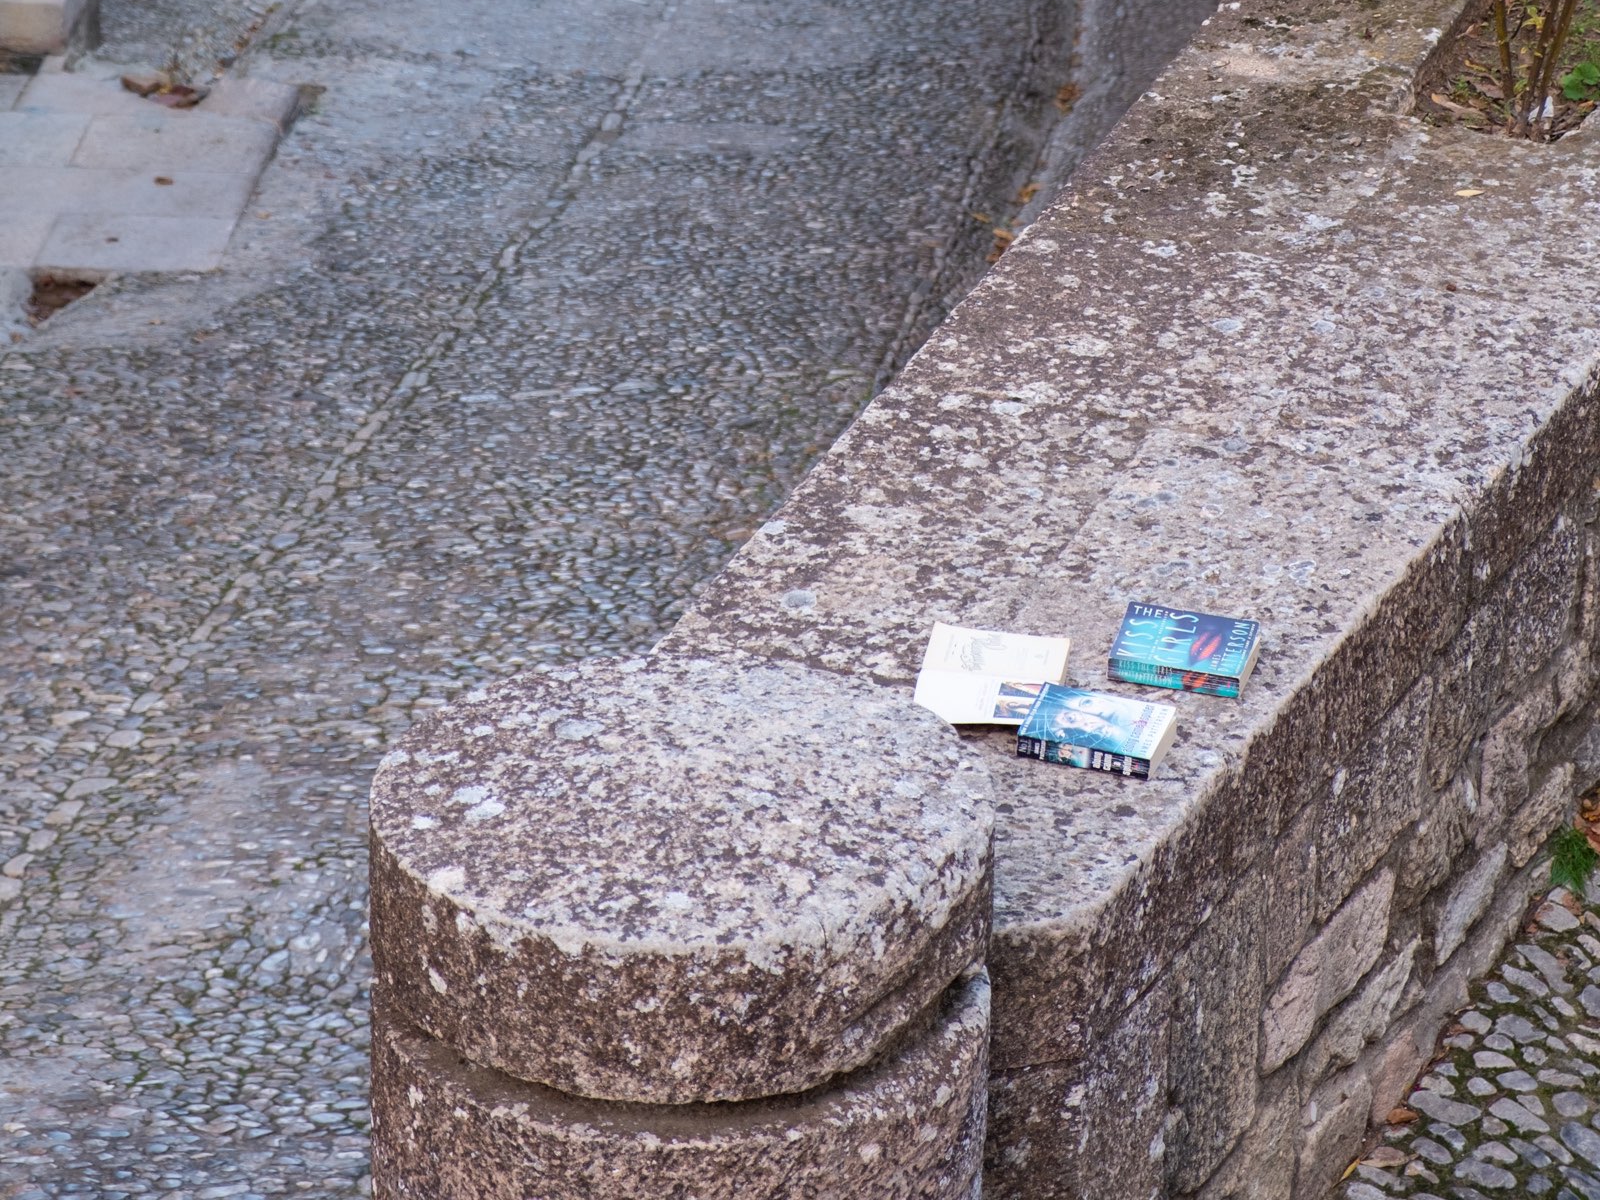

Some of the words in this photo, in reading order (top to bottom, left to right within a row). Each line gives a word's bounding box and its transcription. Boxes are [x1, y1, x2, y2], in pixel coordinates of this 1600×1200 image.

[1133, 605, 1165, 618] THE
[1116, 618, 1158, 660] KISS
[1153, 612, 1200, 664] GIRLS
[1217, 621, 1250, 672] PATTERSON
[1208, 654, 1222, 671] JAMES
[1146, 707, 1169, 738] PATTERSON
